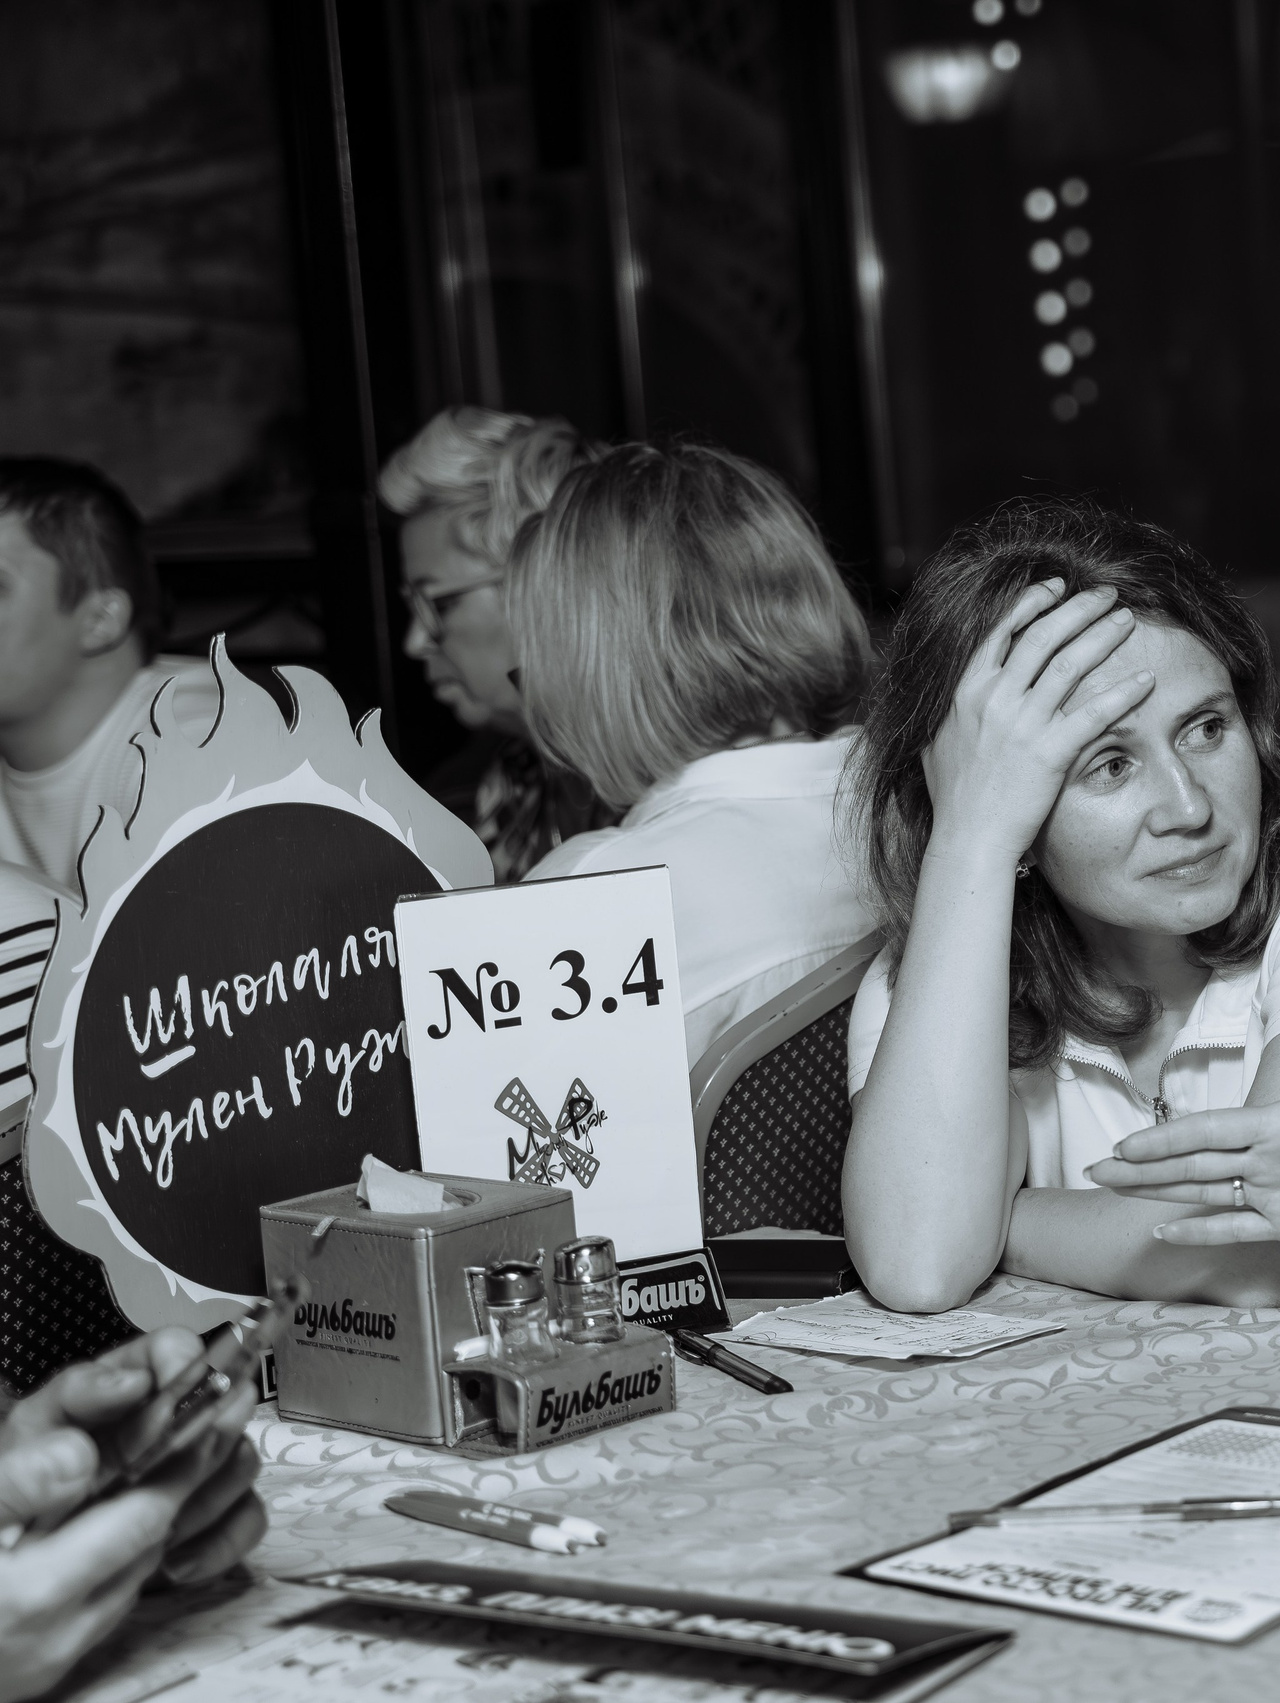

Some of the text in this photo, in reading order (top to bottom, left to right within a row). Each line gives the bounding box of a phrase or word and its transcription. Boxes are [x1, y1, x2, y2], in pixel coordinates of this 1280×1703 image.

[427, 937, 664, 1040] № 3.4
[96, 1075, 273, 1189] Мулен
[632, 1313, 674, 1326] QUALITY
[536, 1364, 663, 1435] Бульбашъ
